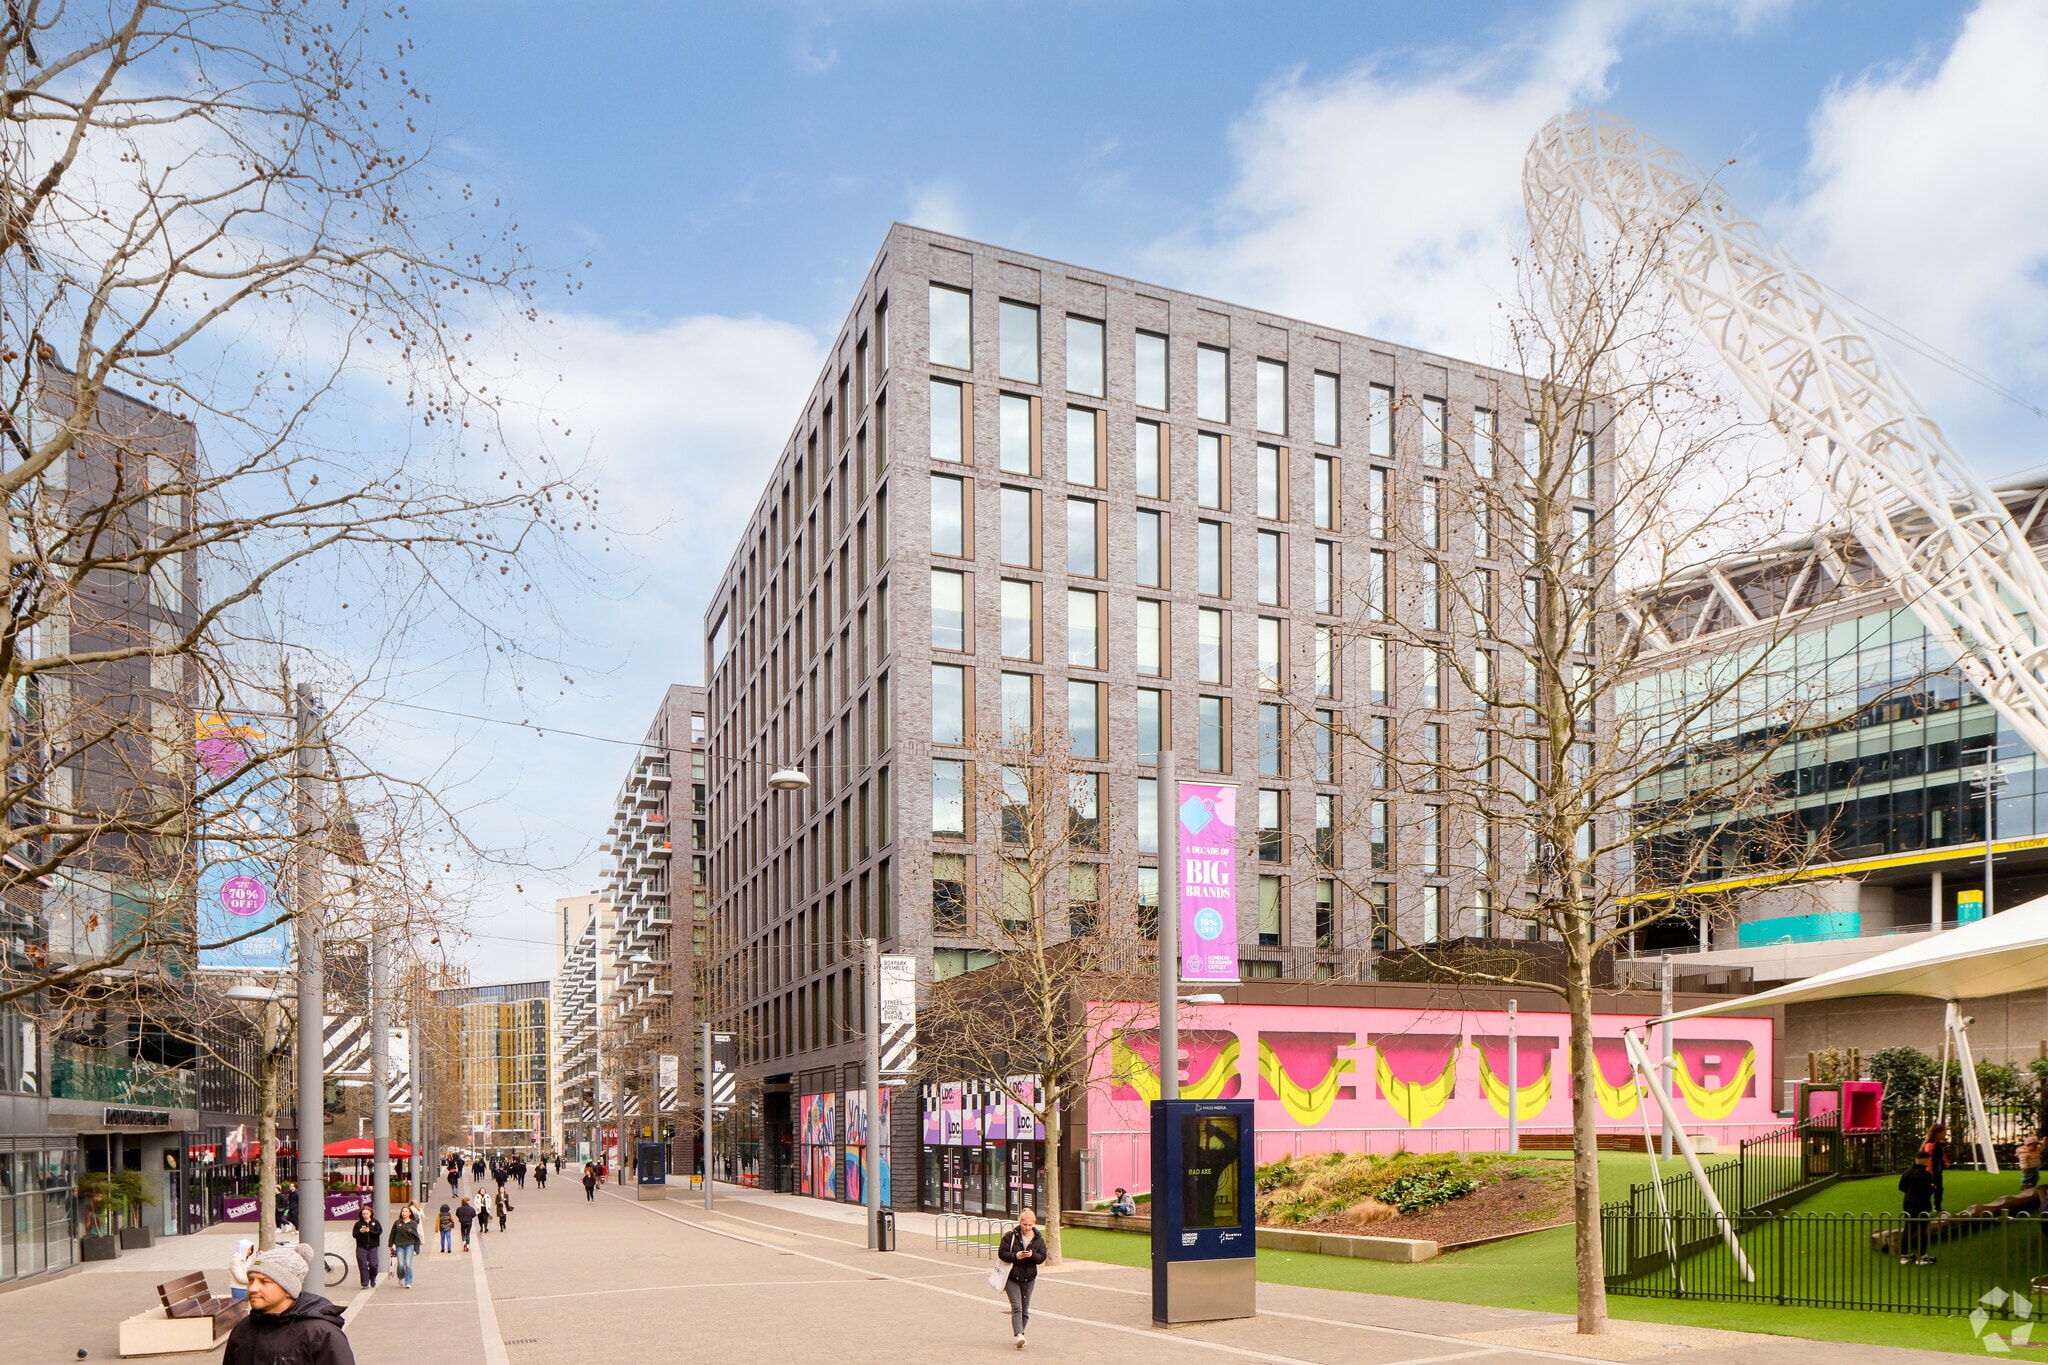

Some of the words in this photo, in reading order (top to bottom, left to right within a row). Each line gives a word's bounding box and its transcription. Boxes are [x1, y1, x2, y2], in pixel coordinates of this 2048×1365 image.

[2007, 839, 2045, 850] YELLOW
[1185, 846, 1191, 854] A
[1191, 846, 1220, 855] DECADE
[1220, 848, 1230, 856] OF
[1185, 859, 1230, 886] BIG
[229, 888, 259, 900] 70%
[1185, 885, 1231, 898] BRANDS
